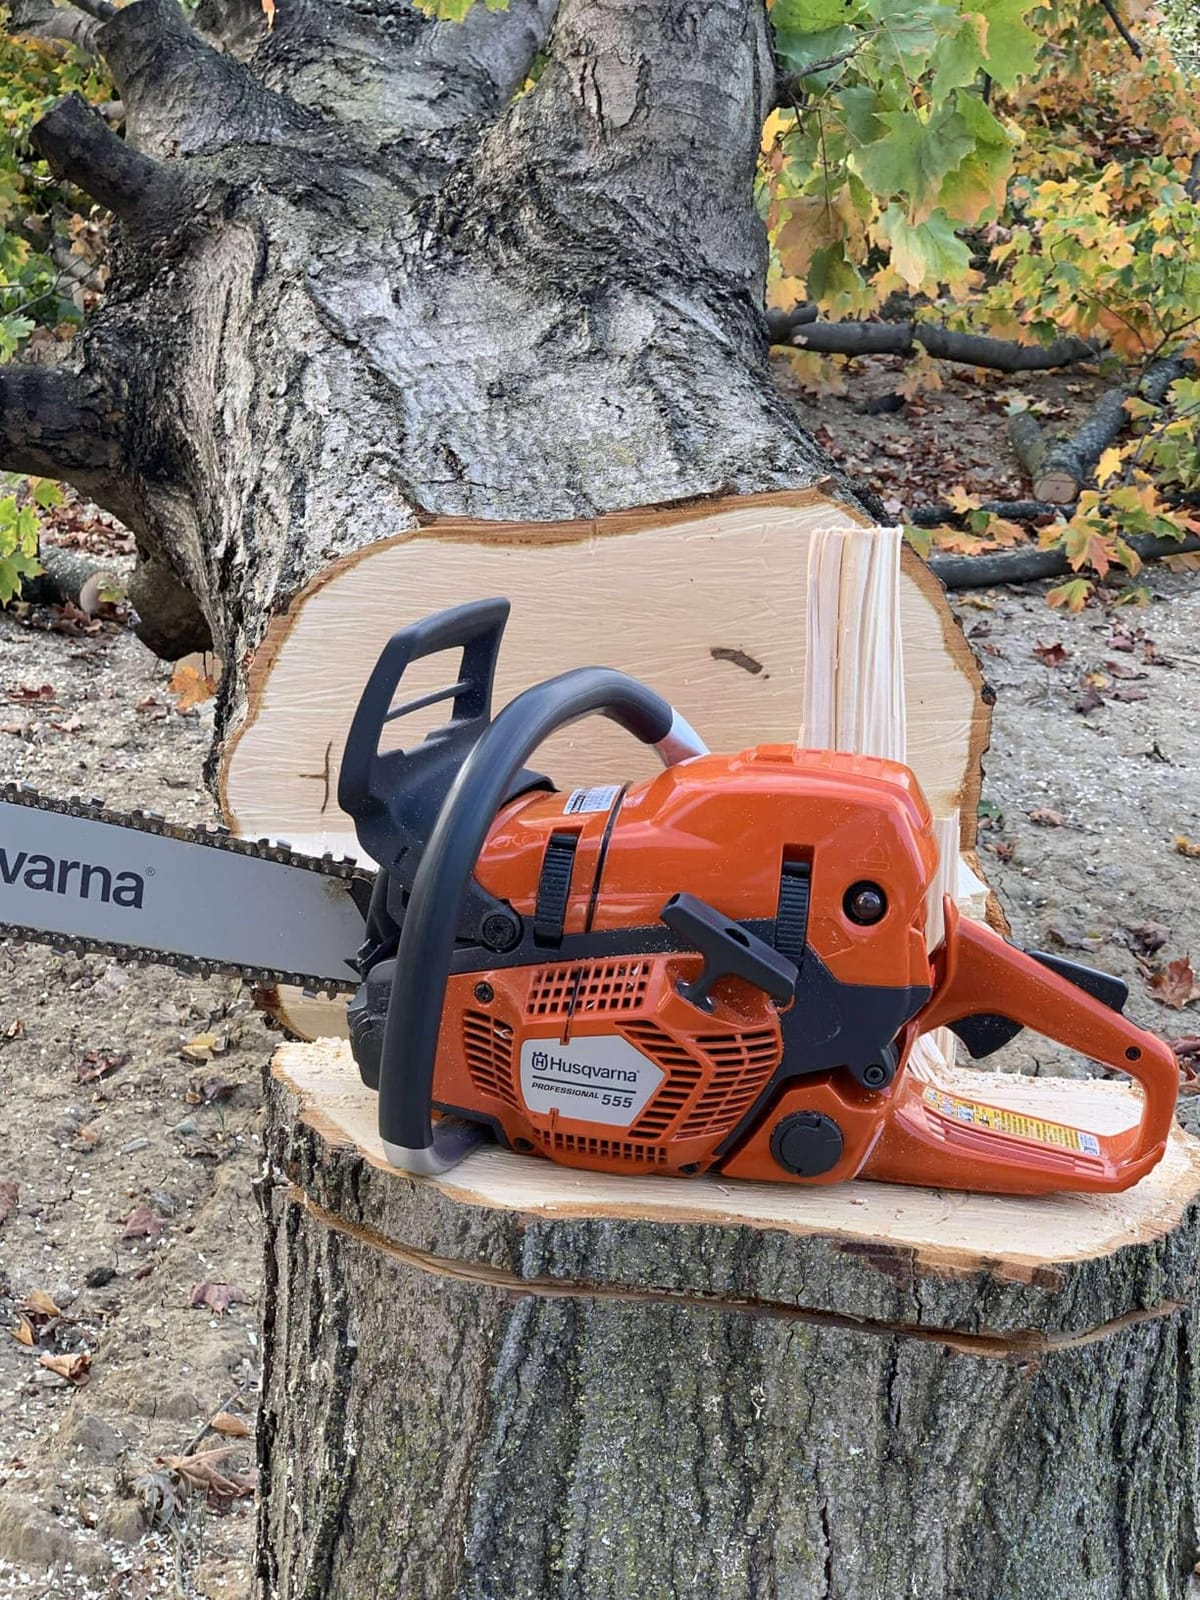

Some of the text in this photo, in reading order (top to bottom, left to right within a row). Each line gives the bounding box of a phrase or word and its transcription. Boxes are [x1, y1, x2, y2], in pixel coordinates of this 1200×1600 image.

[550, 1056, 637, 1082] Husqvarna
[531, 1081, 633, 1108] PROFESSIONAL 555
